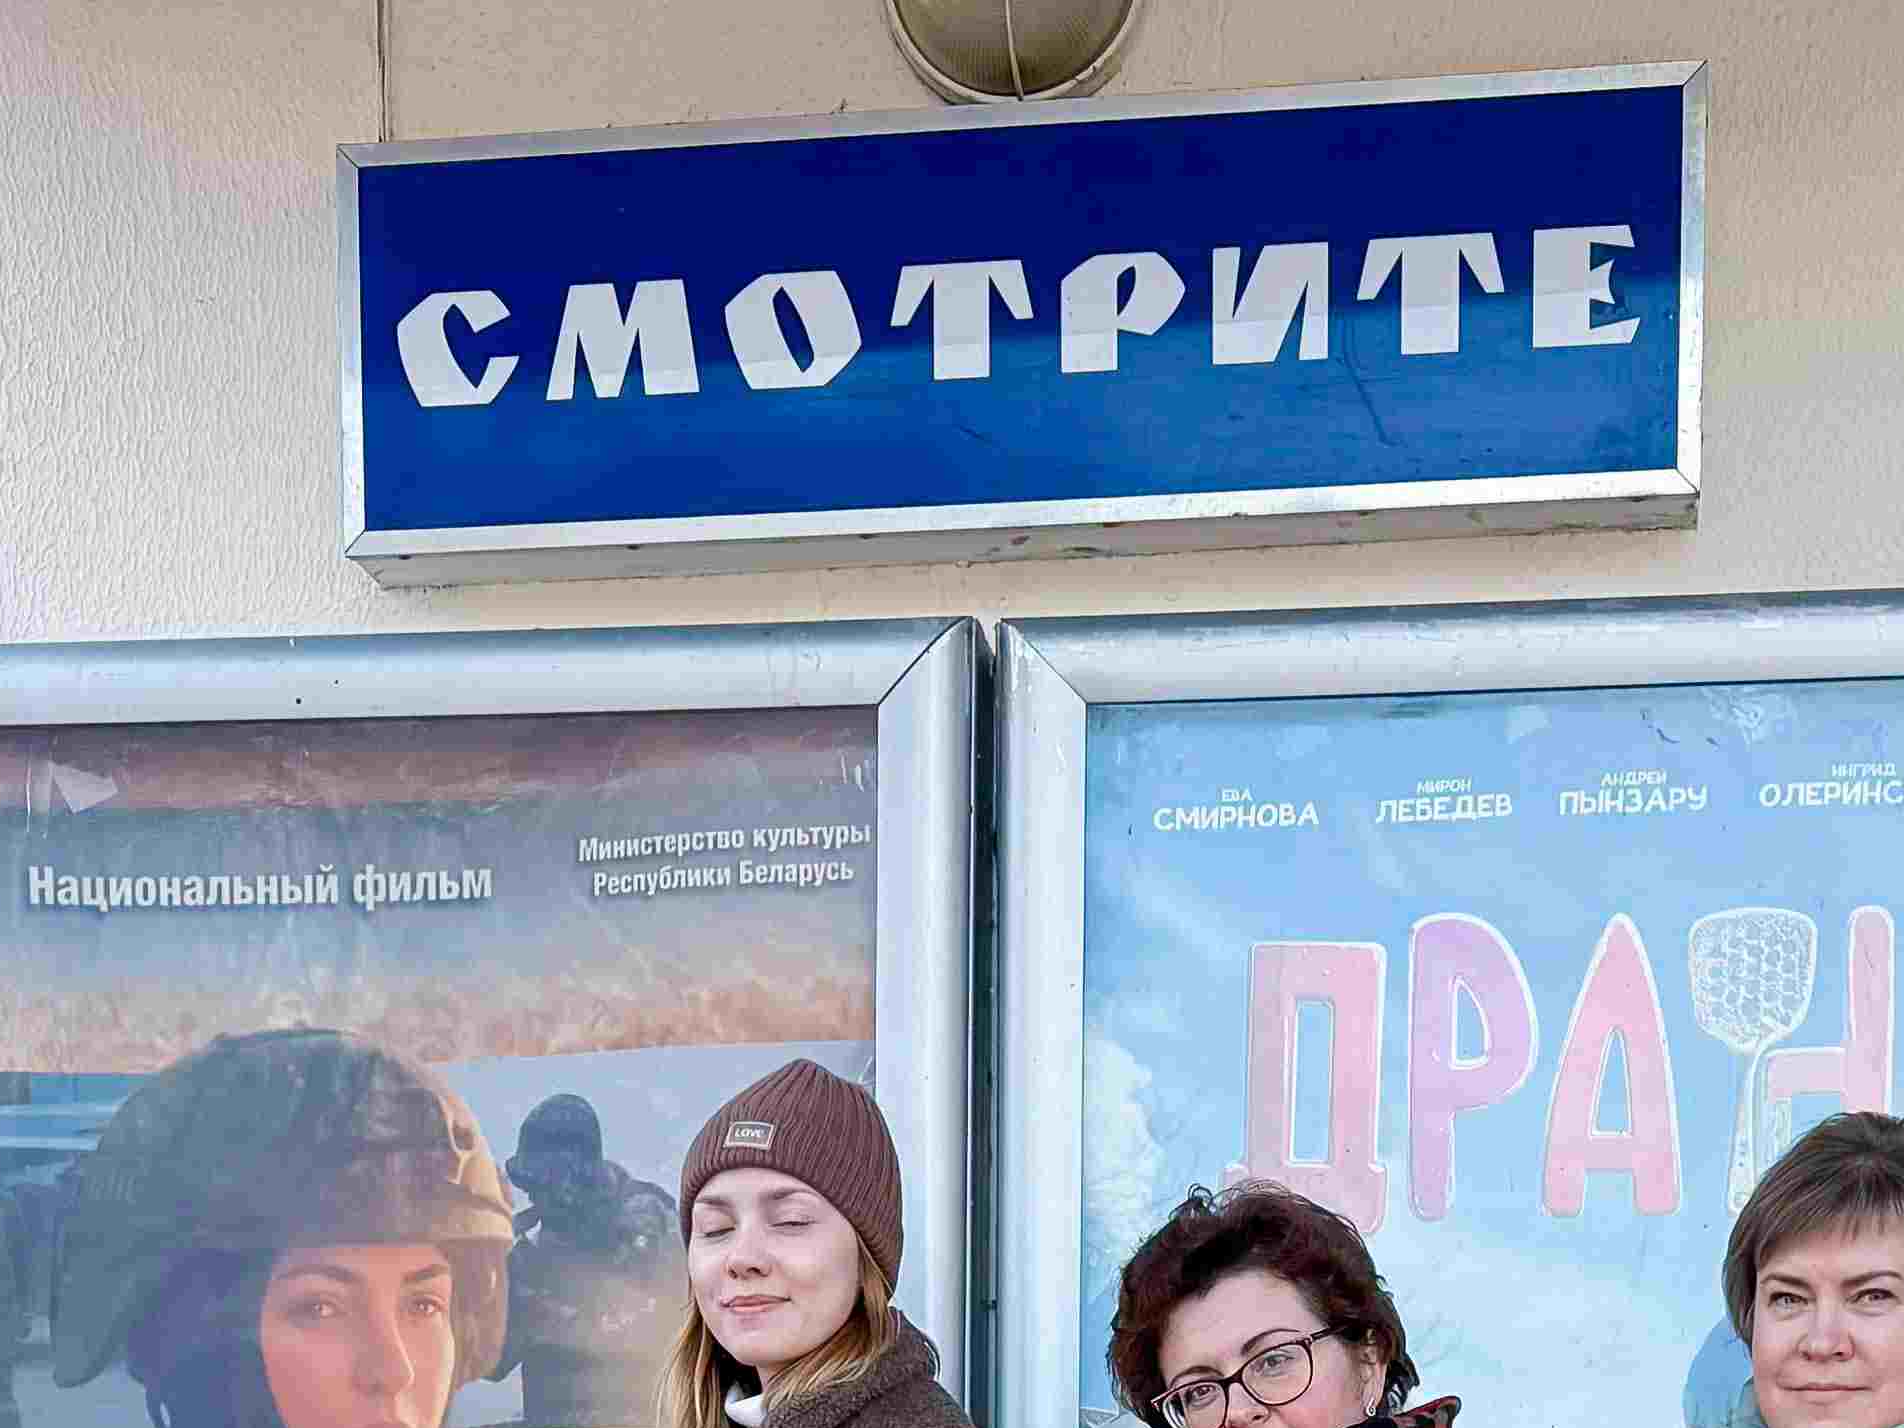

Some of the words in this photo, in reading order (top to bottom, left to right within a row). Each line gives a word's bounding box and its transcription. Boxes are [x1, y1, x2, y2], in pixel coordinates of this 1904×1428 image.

[395, 224, 1643, 408] СМОТРИТЕ
[1416, 777, 1472, 793] МИРОН
[1559, 785, 1708, 817] ПЫНЗАРУ
[1153, 801, 1319, 832] СМИРНОВА
[1375, 793, 1513, 824] ЛЕБЕДЕВ
[579, 829, 745, 862] Министерство
[753, 824, 870, 851] культуры
[28, 864, 339, 912] Национальный
[353, 864, 493, 911] фильм
[594, 862, 730, 896] Республики
[739, 858, 854, 886] Беларусь
